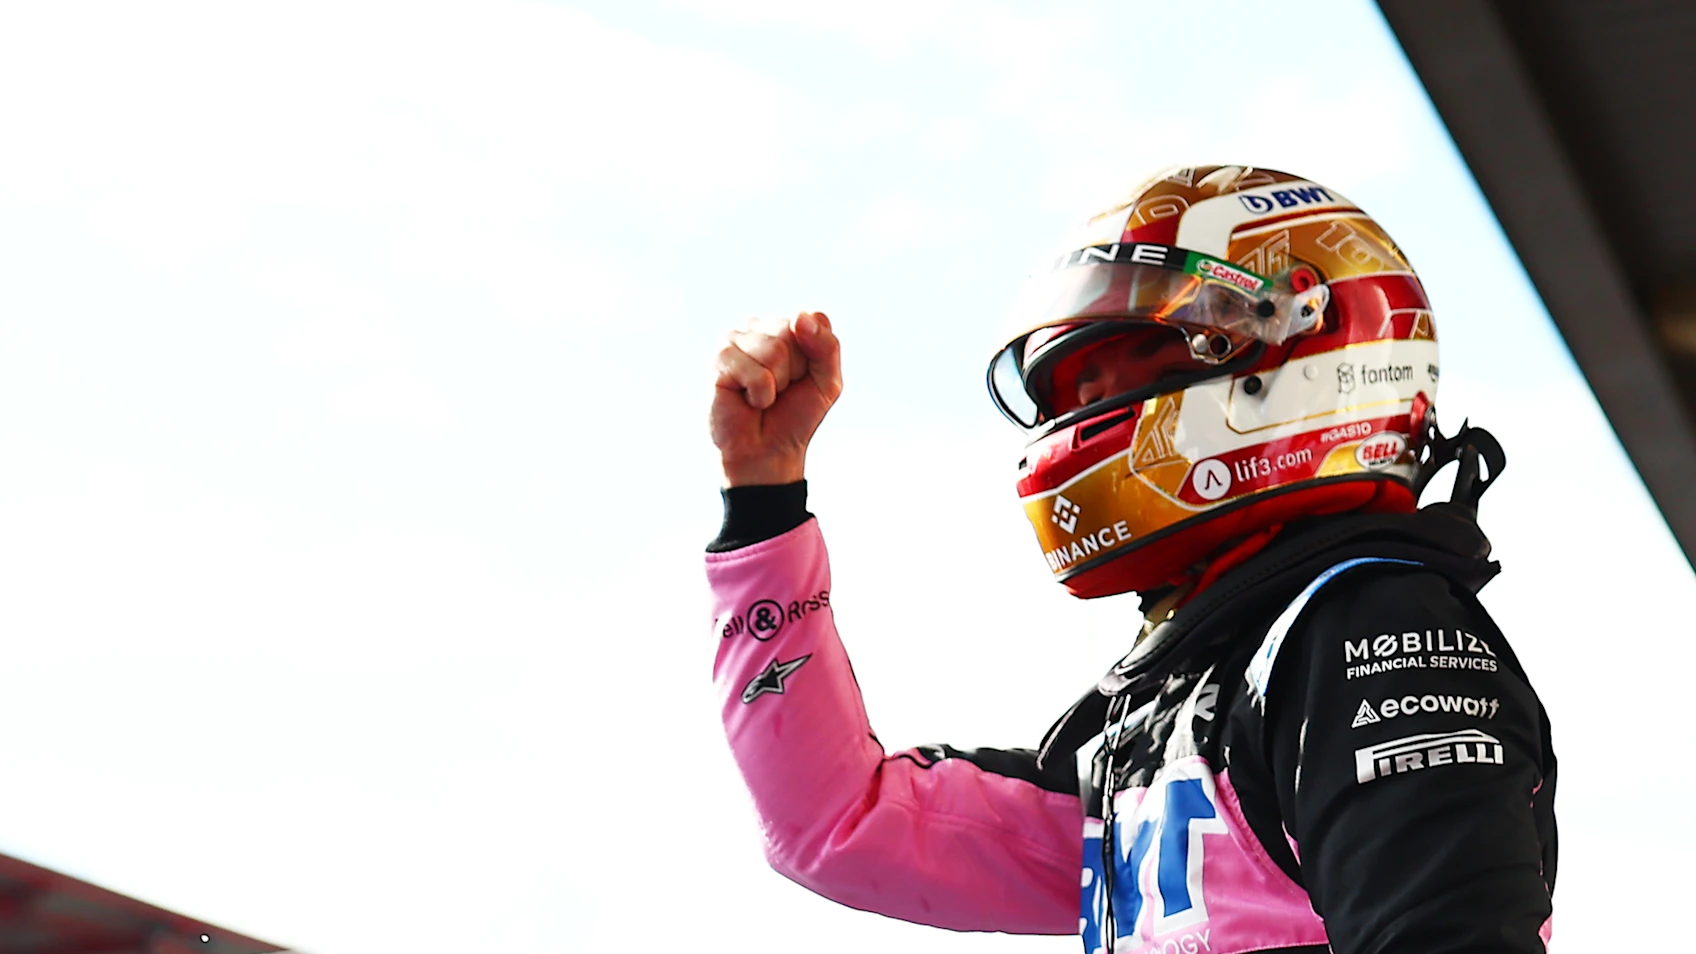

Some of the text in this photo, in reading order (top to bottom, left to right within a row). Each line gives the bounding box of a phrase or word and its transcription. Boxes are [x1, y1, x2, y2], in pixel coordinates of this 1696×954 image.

[1271, 187, 1335, 208] BWT
[1212, 265, 1261, 292] Castrol
[1361, 364, 1413, 385] fantom
[1235, 447, 1314, 483] lif3.com
[1044, 520, 1132, 571] BINANCE
[1346, 655, 1499, 680] FINANCIAL SERVICES
[1380, 694, 1501, 719] ecowatt
[1354, 728, 1504, 784] PIRELLI
